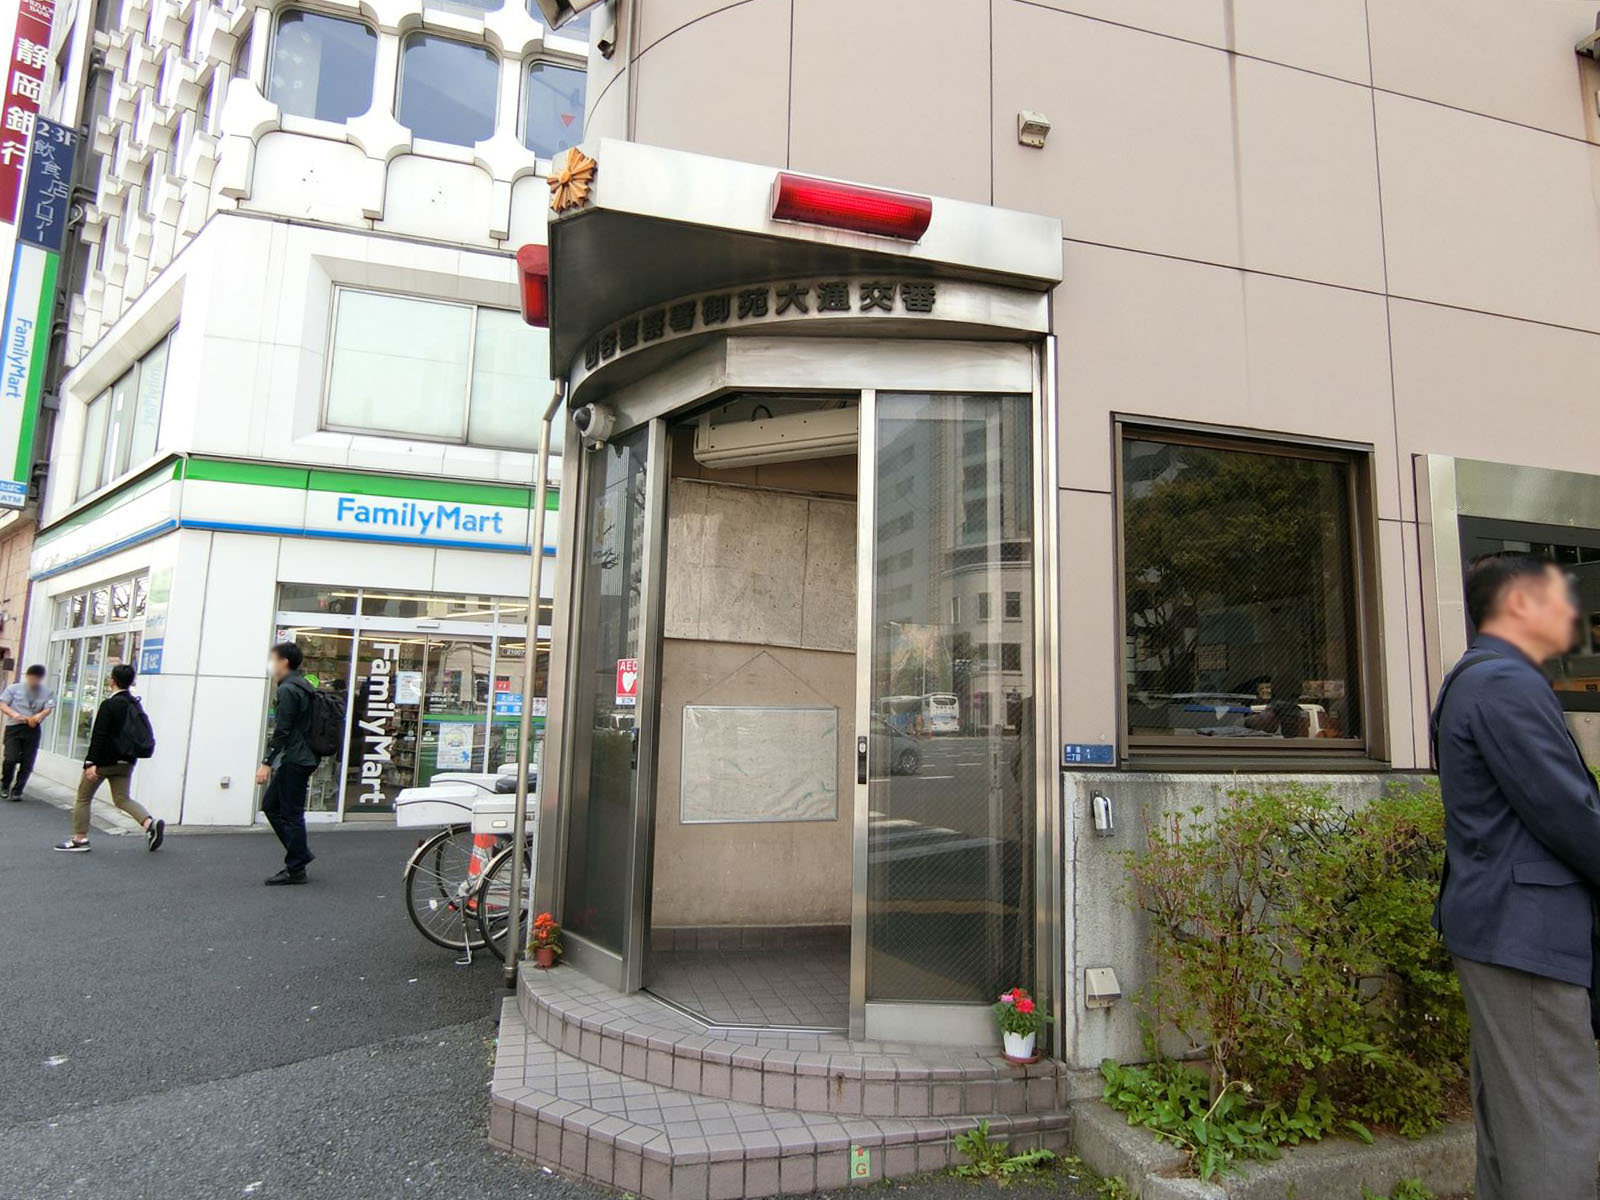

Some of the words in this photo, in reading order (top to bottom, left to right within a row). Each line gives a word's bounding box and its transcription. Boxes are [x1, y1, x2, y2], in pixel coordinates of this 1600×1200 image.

[1, 36, 49, 170] 静岡銀行
[6, 317, 33, 398] FamilyMart
[0, 494, 22, 503] ATM
[336, 496, 504, 536] FamilyMart
[620, 660, 638, 671] AED
[358, 642, 402, 804] FamilyMart
[855, 1161, 867, 1176] G
